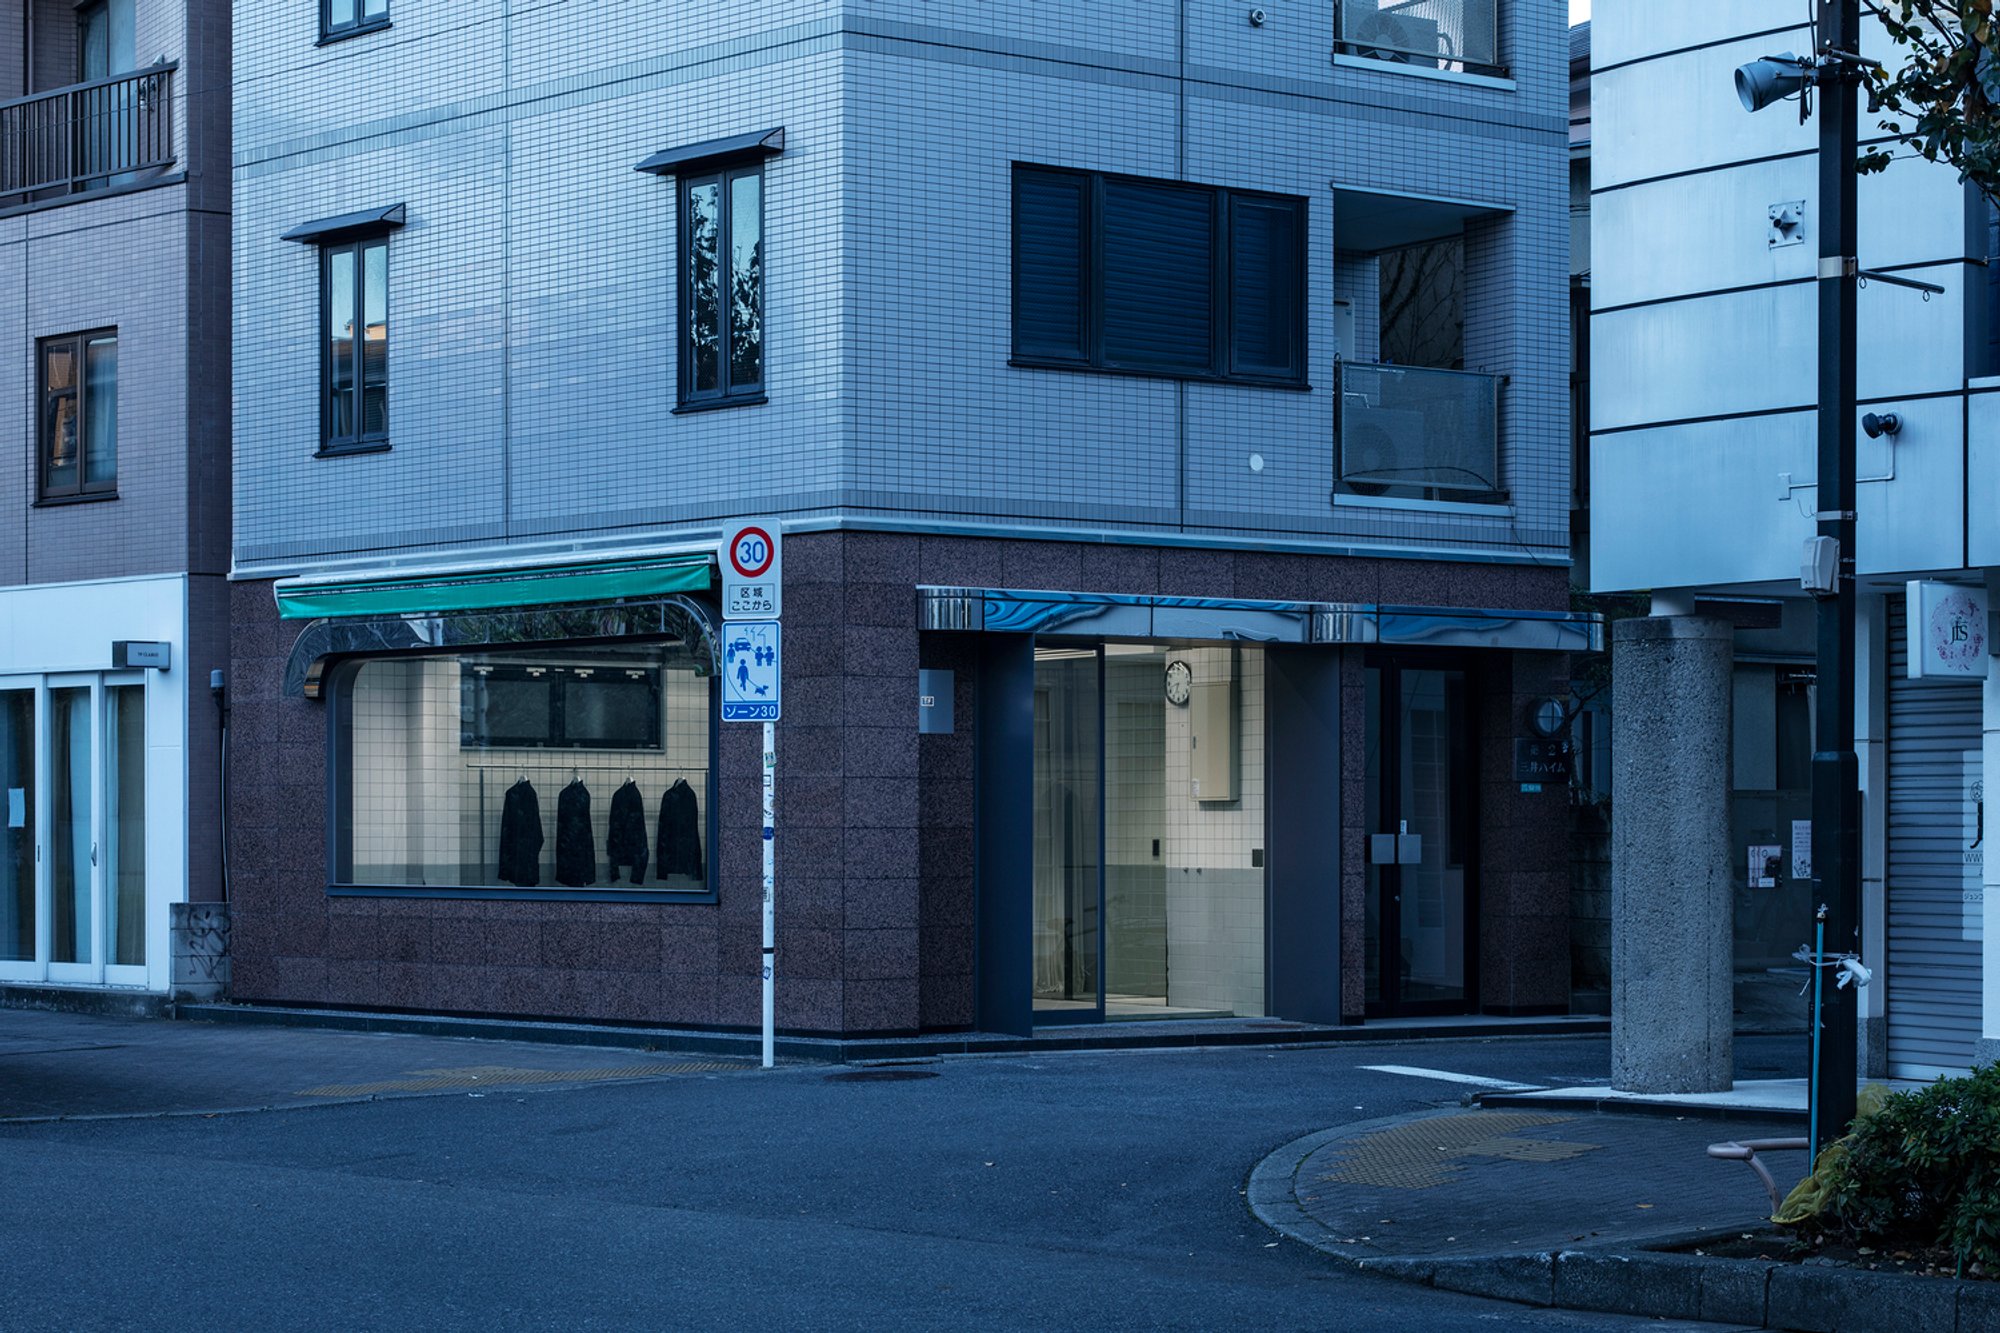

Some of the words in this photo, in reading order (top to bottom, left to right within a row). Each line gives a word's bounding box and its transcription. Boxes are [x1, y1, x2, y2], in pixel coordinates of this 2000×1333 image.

[740, 541, 765, 564] 30
[740, 587, 763, 599] 区域
[731, 600, 772, 611] ここから
